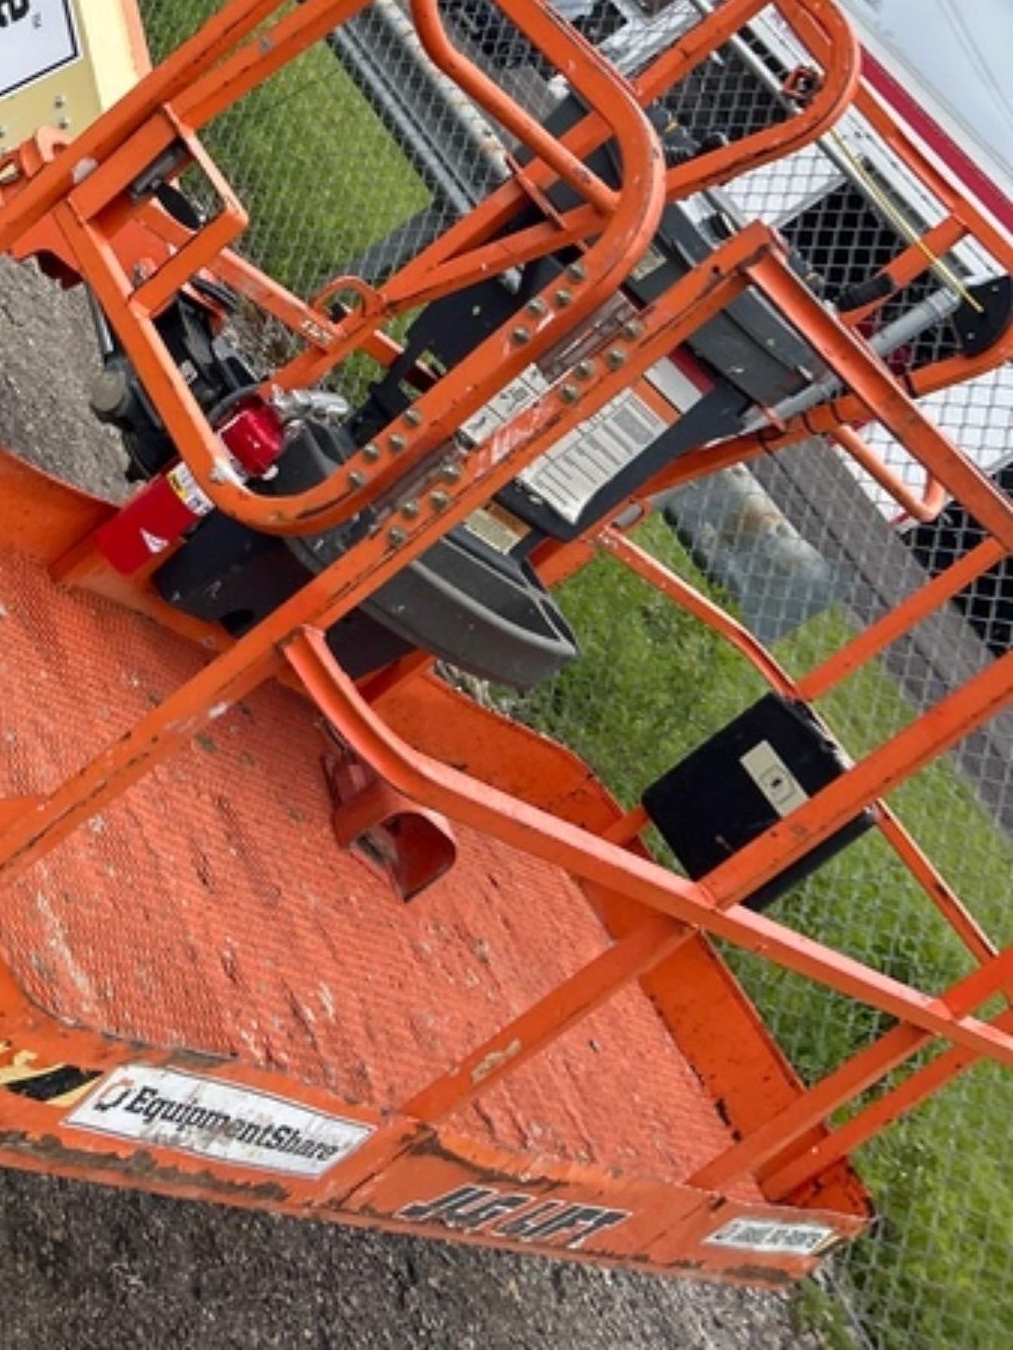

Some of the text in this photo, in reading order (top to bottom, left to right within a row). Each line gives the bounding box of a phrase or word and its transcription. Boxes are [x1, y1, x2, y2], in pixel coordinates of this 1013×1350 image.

[124, 1086, 338, 1161] EquipmentShare
[396, 1184, 633, 1248] JLG LIFT
